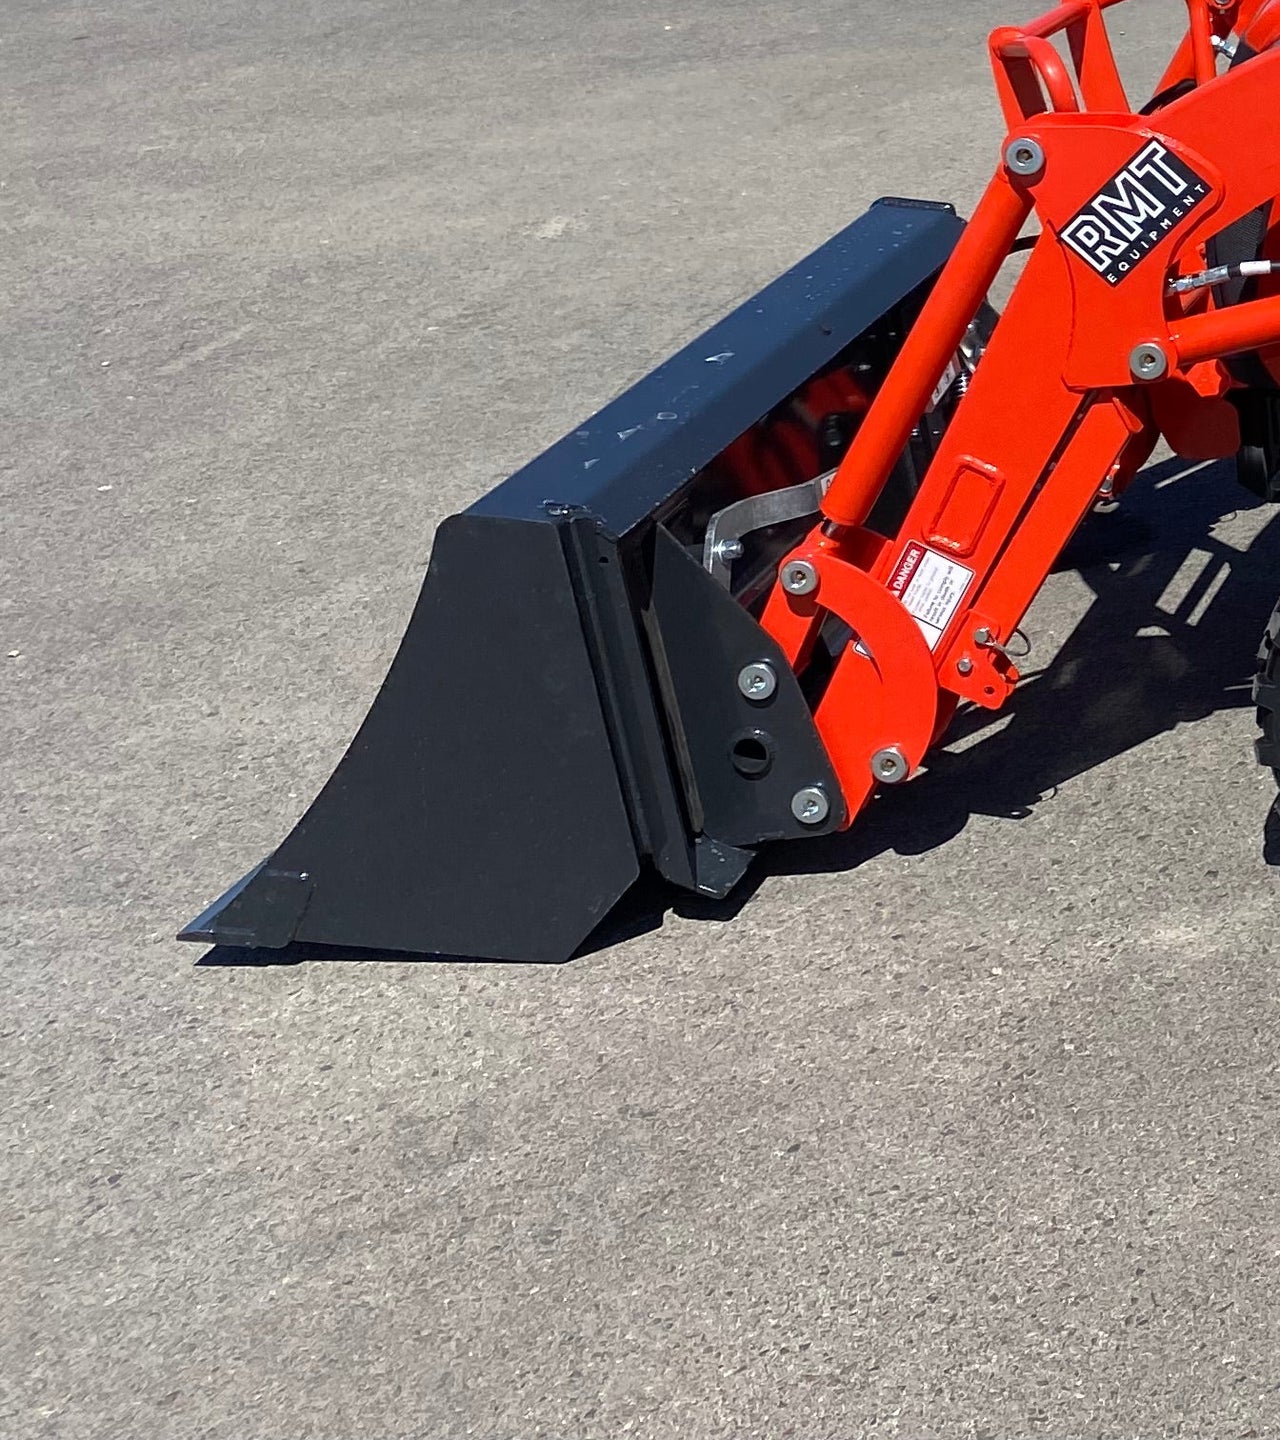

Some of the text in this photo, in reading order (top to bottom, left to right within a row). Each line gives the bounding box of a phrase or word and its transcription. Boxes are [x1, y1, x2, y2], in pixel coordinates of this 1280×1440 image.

[1061, 140, 1189, 273] RMT
[1107, 183, 1206, 285] EQUIPMENT
[893, 548, 921, 592] DANGER
